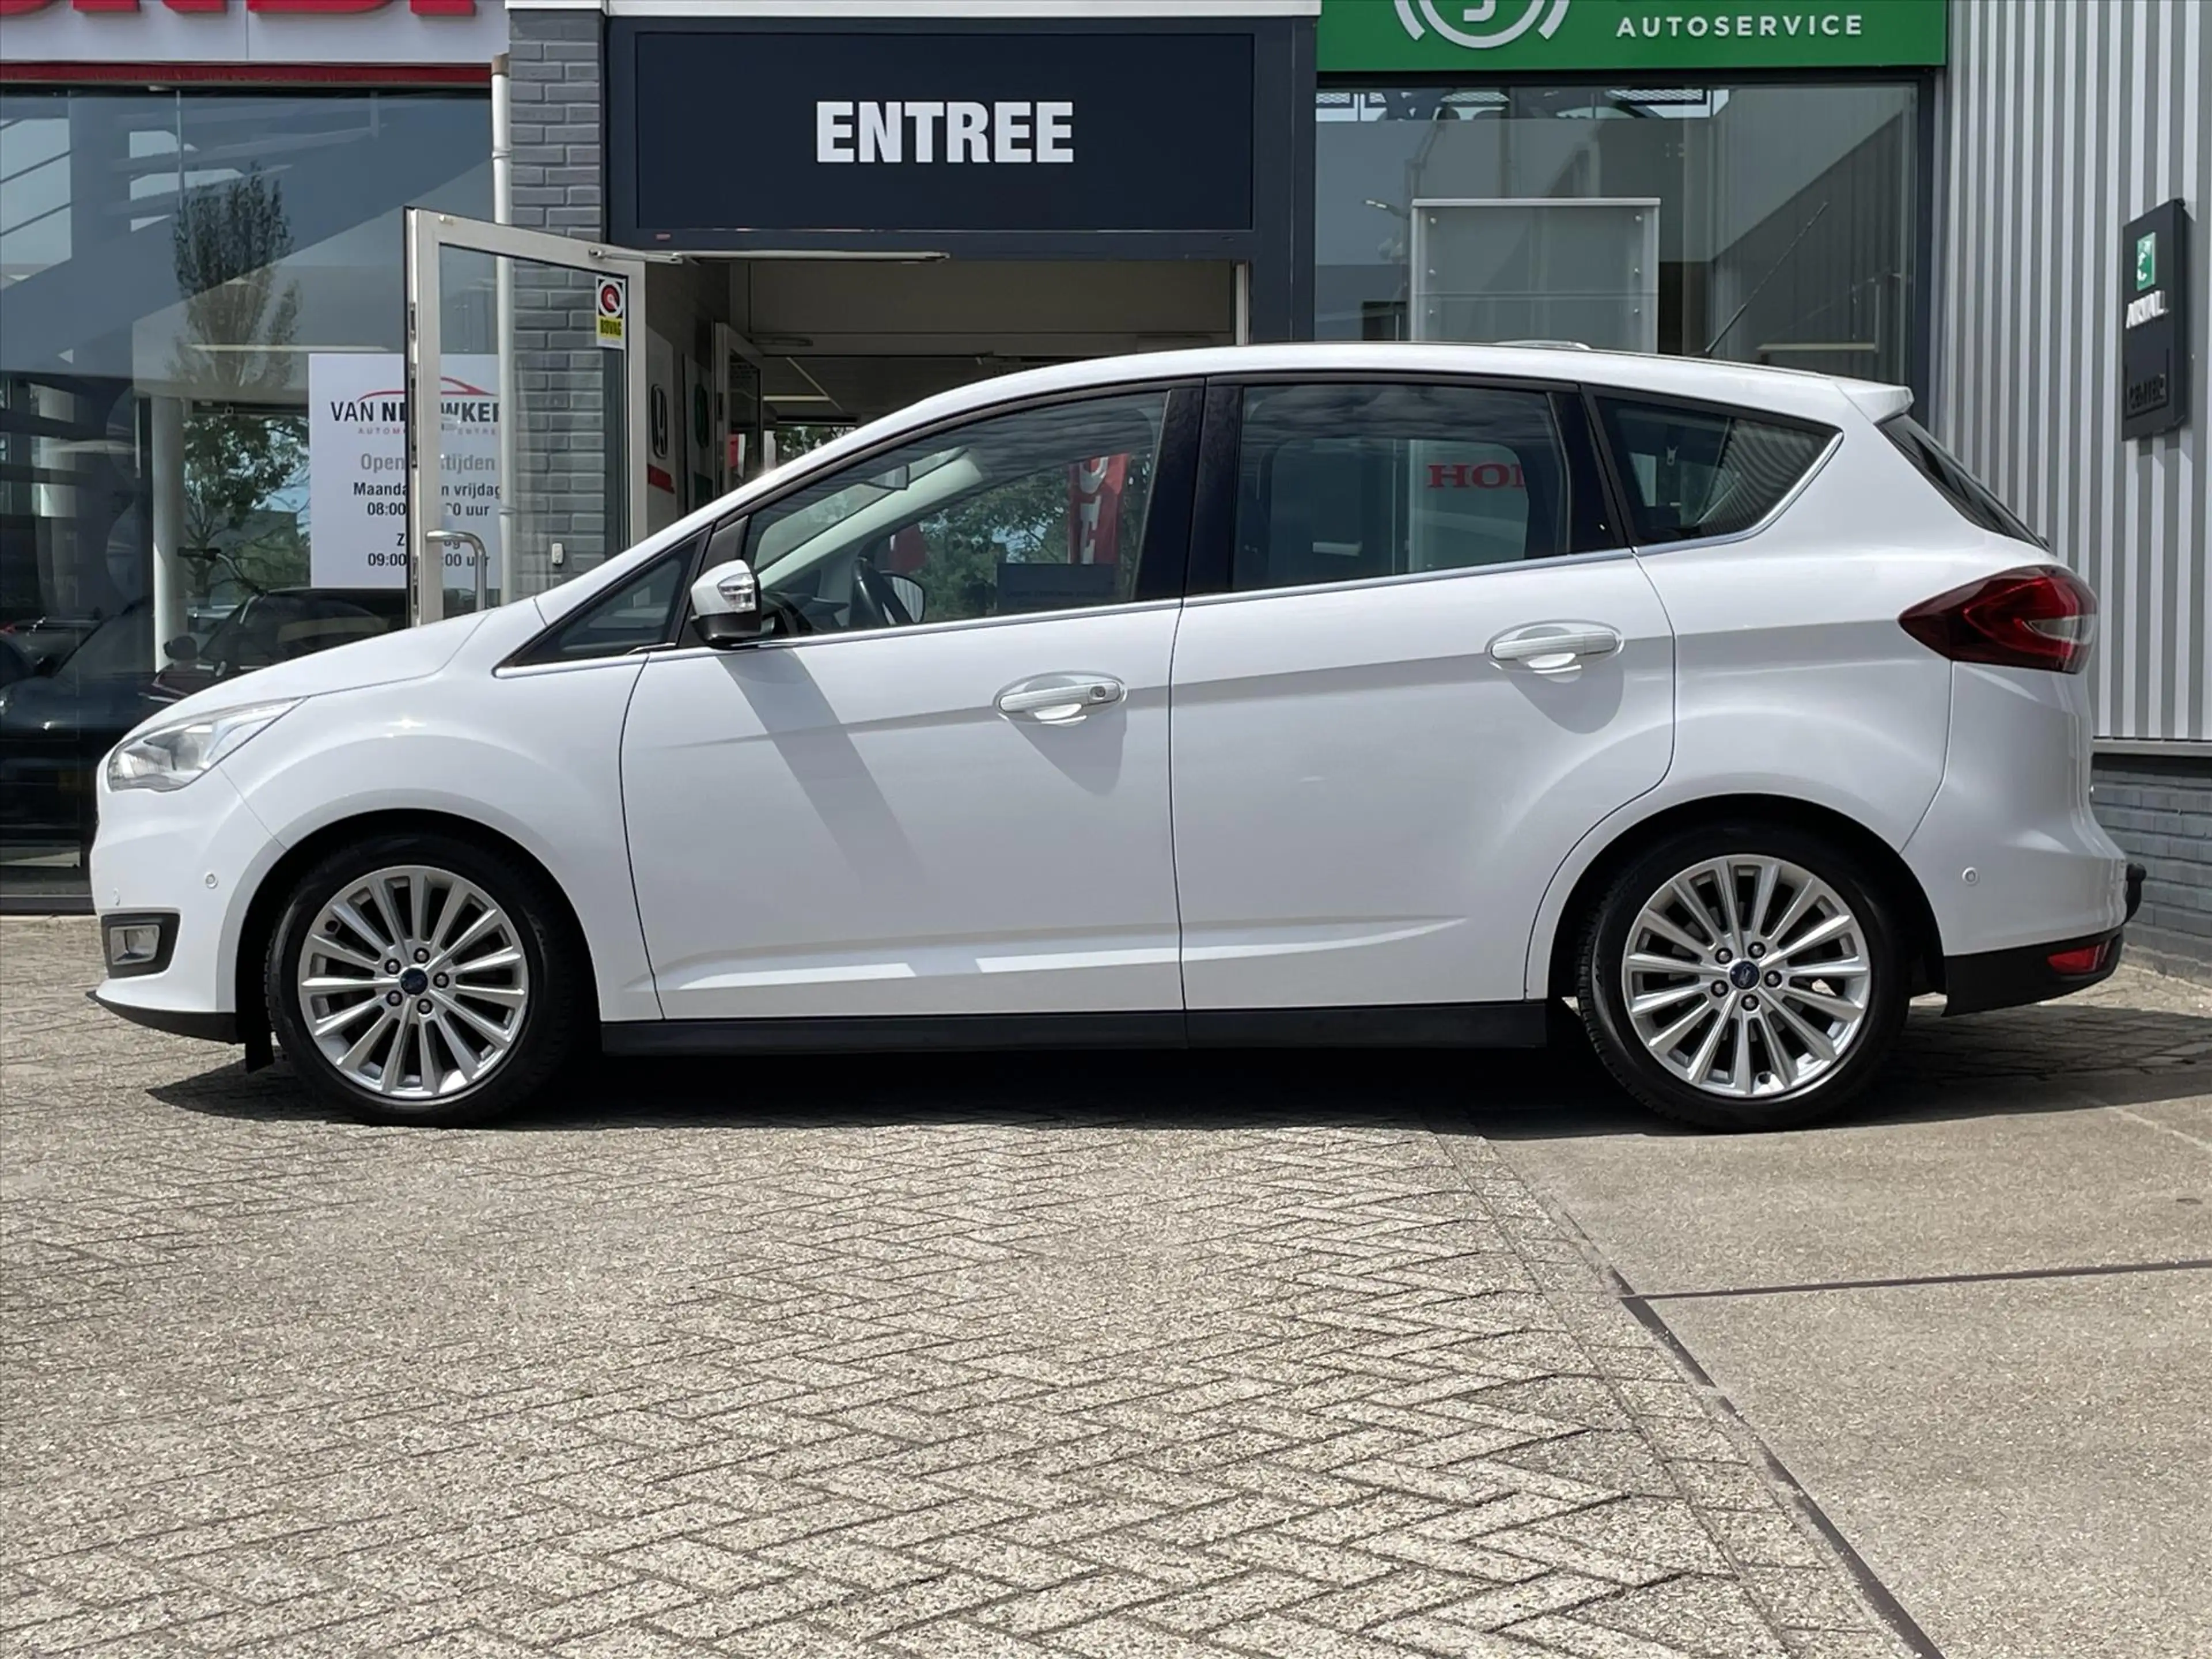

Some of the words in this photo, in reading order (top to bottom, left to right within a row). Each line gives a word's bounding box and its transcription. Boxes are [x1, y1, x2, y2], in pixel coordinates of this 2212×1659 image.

[1616, 15, 1862, 37] AUTOSERVICE
[817, 101, 1074, 163] ENTREE
[331, 402, 374, 422] VAN
[367, 502, 407, 516] 08:00
[465, 505, 490, 517] uur
[368, 553, 407, 567] 09:00
